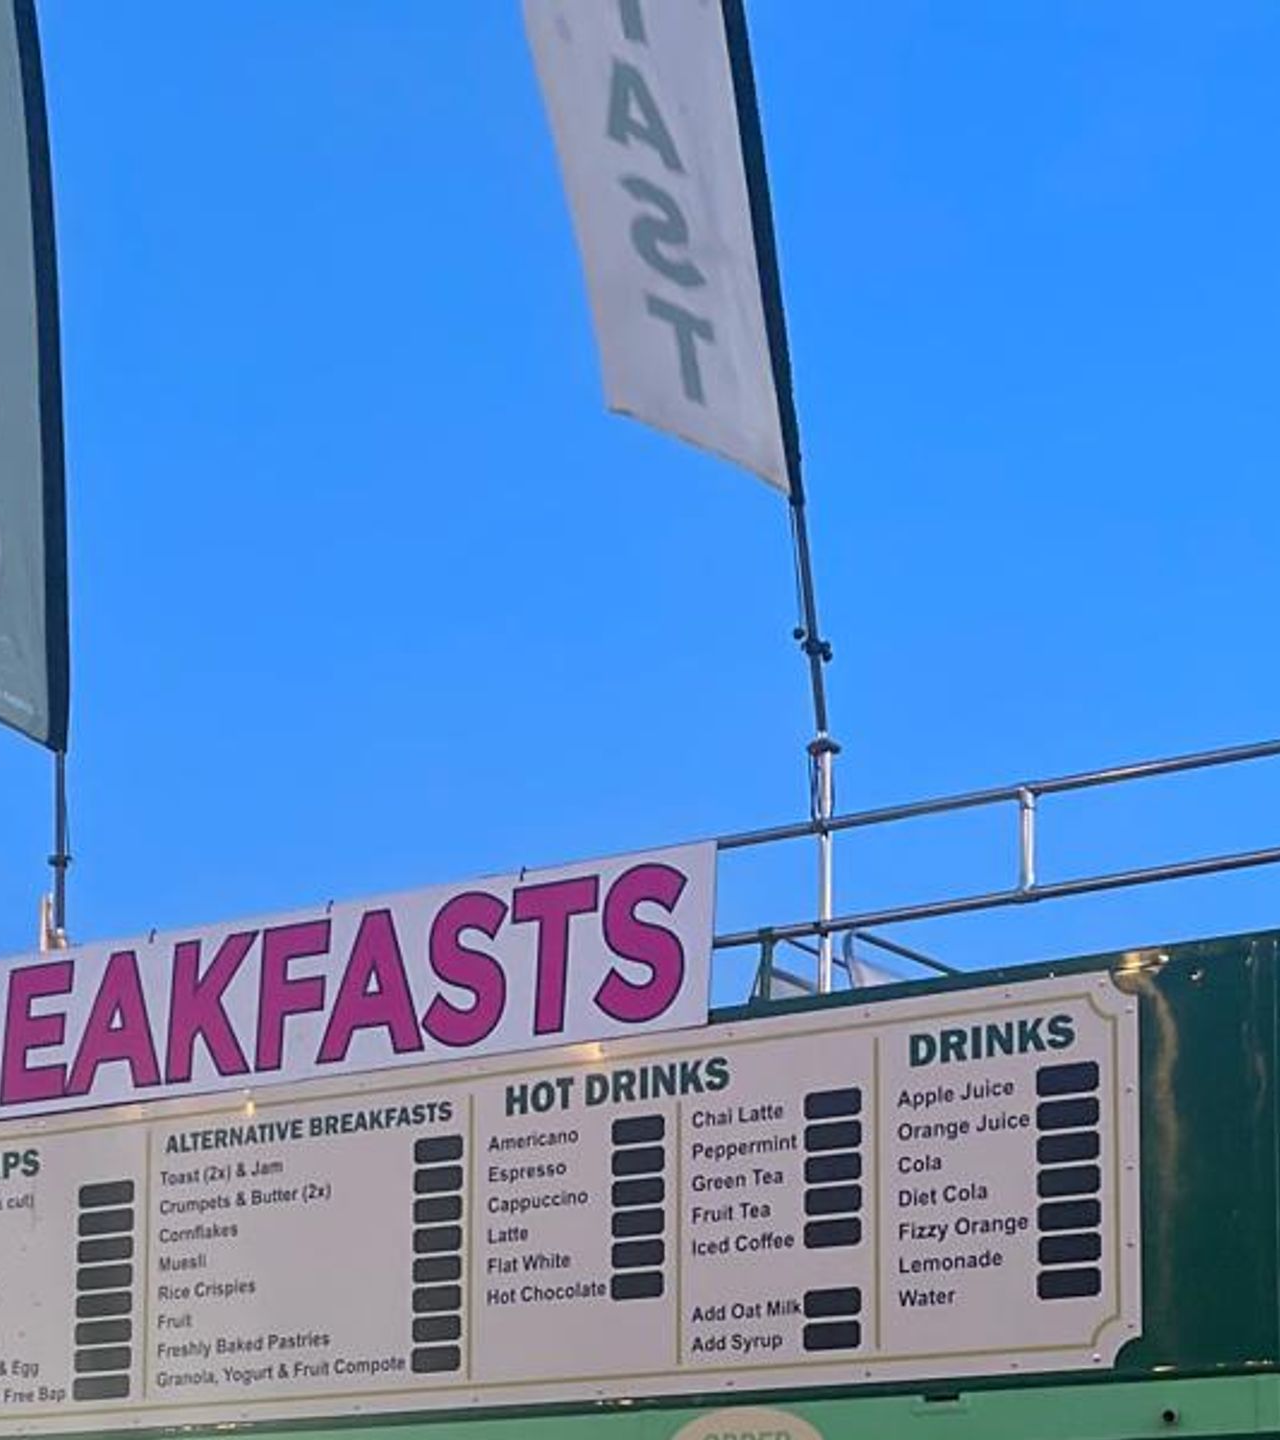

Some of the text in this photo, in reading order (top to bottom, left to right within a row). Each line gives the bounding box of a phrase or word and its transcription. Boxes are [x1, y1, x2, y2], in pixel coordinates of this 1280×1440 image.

[909, 1014, 1075, 1067] DRINKS
[505, 1056, 730, 1117] HOT DRINKS
[897, 1078, 1015, 1110] Apple Juice
[165, 1101, 453, 1154] ALTERNATIVE BREAKFASTS
[691, 1104, 784, 1130] Chai Latte
[897, 1111, 1031, 1142] Orange Juice
[488, 1129, 579, 1152] Americano
[692, 1134, 798, 1162] Peppermint
[160, 1159, 284, 1187] Toast (2x) & Jam
[488, 1162, 567, 1183] Espresso
[898, 1154, 942, 1174] Cola
[691, 1168, 784, 1192] Green Tea
[6, 1193, 35, 1211] cut)
[159, 1183, 332, 1216] Crumpets & Butter (2x)
[487, 1190, 589, 1214] Cappuccino
[898, 1183, 988, 1208] Diet Cola
[692, 1202, 771, 1225] Fruit Tea
[159, 1222, 239, 1244] Cornflakes
[487, 1227, 529, 1245] Latte
[898, 1215, 1029, 1243] Fizzy Orange
[692, 1231, 795, 1257] Iced Coffee
[158, 1253, 208, 1272] Muesli
[487, 1252, 572, 1275] Flat White
[898, 1249, 1004, 1274] Lemonade
[157, 1279, 257, 1301] Rice Crispies
[486, 1281, 607, 1306] Hot Chocolate
[898, 1288, 956, 1307] Water
[157, 1313, 192, 1330] Fruit
[692, 1299, 802, 1323] Add Oat Milk
[157, 1331, 330, 1359] Freshly Baked Pastries
[692, 1333, 783, 1353] Add Syrup
[11, 1360, 40, 1379] Egg
[156, 1355, 406, 1388] Granola, Yogurt & Fruit Compote
[3, 1388, 34, 1404] Free
[38, 1386, 66, 1403] Bap
